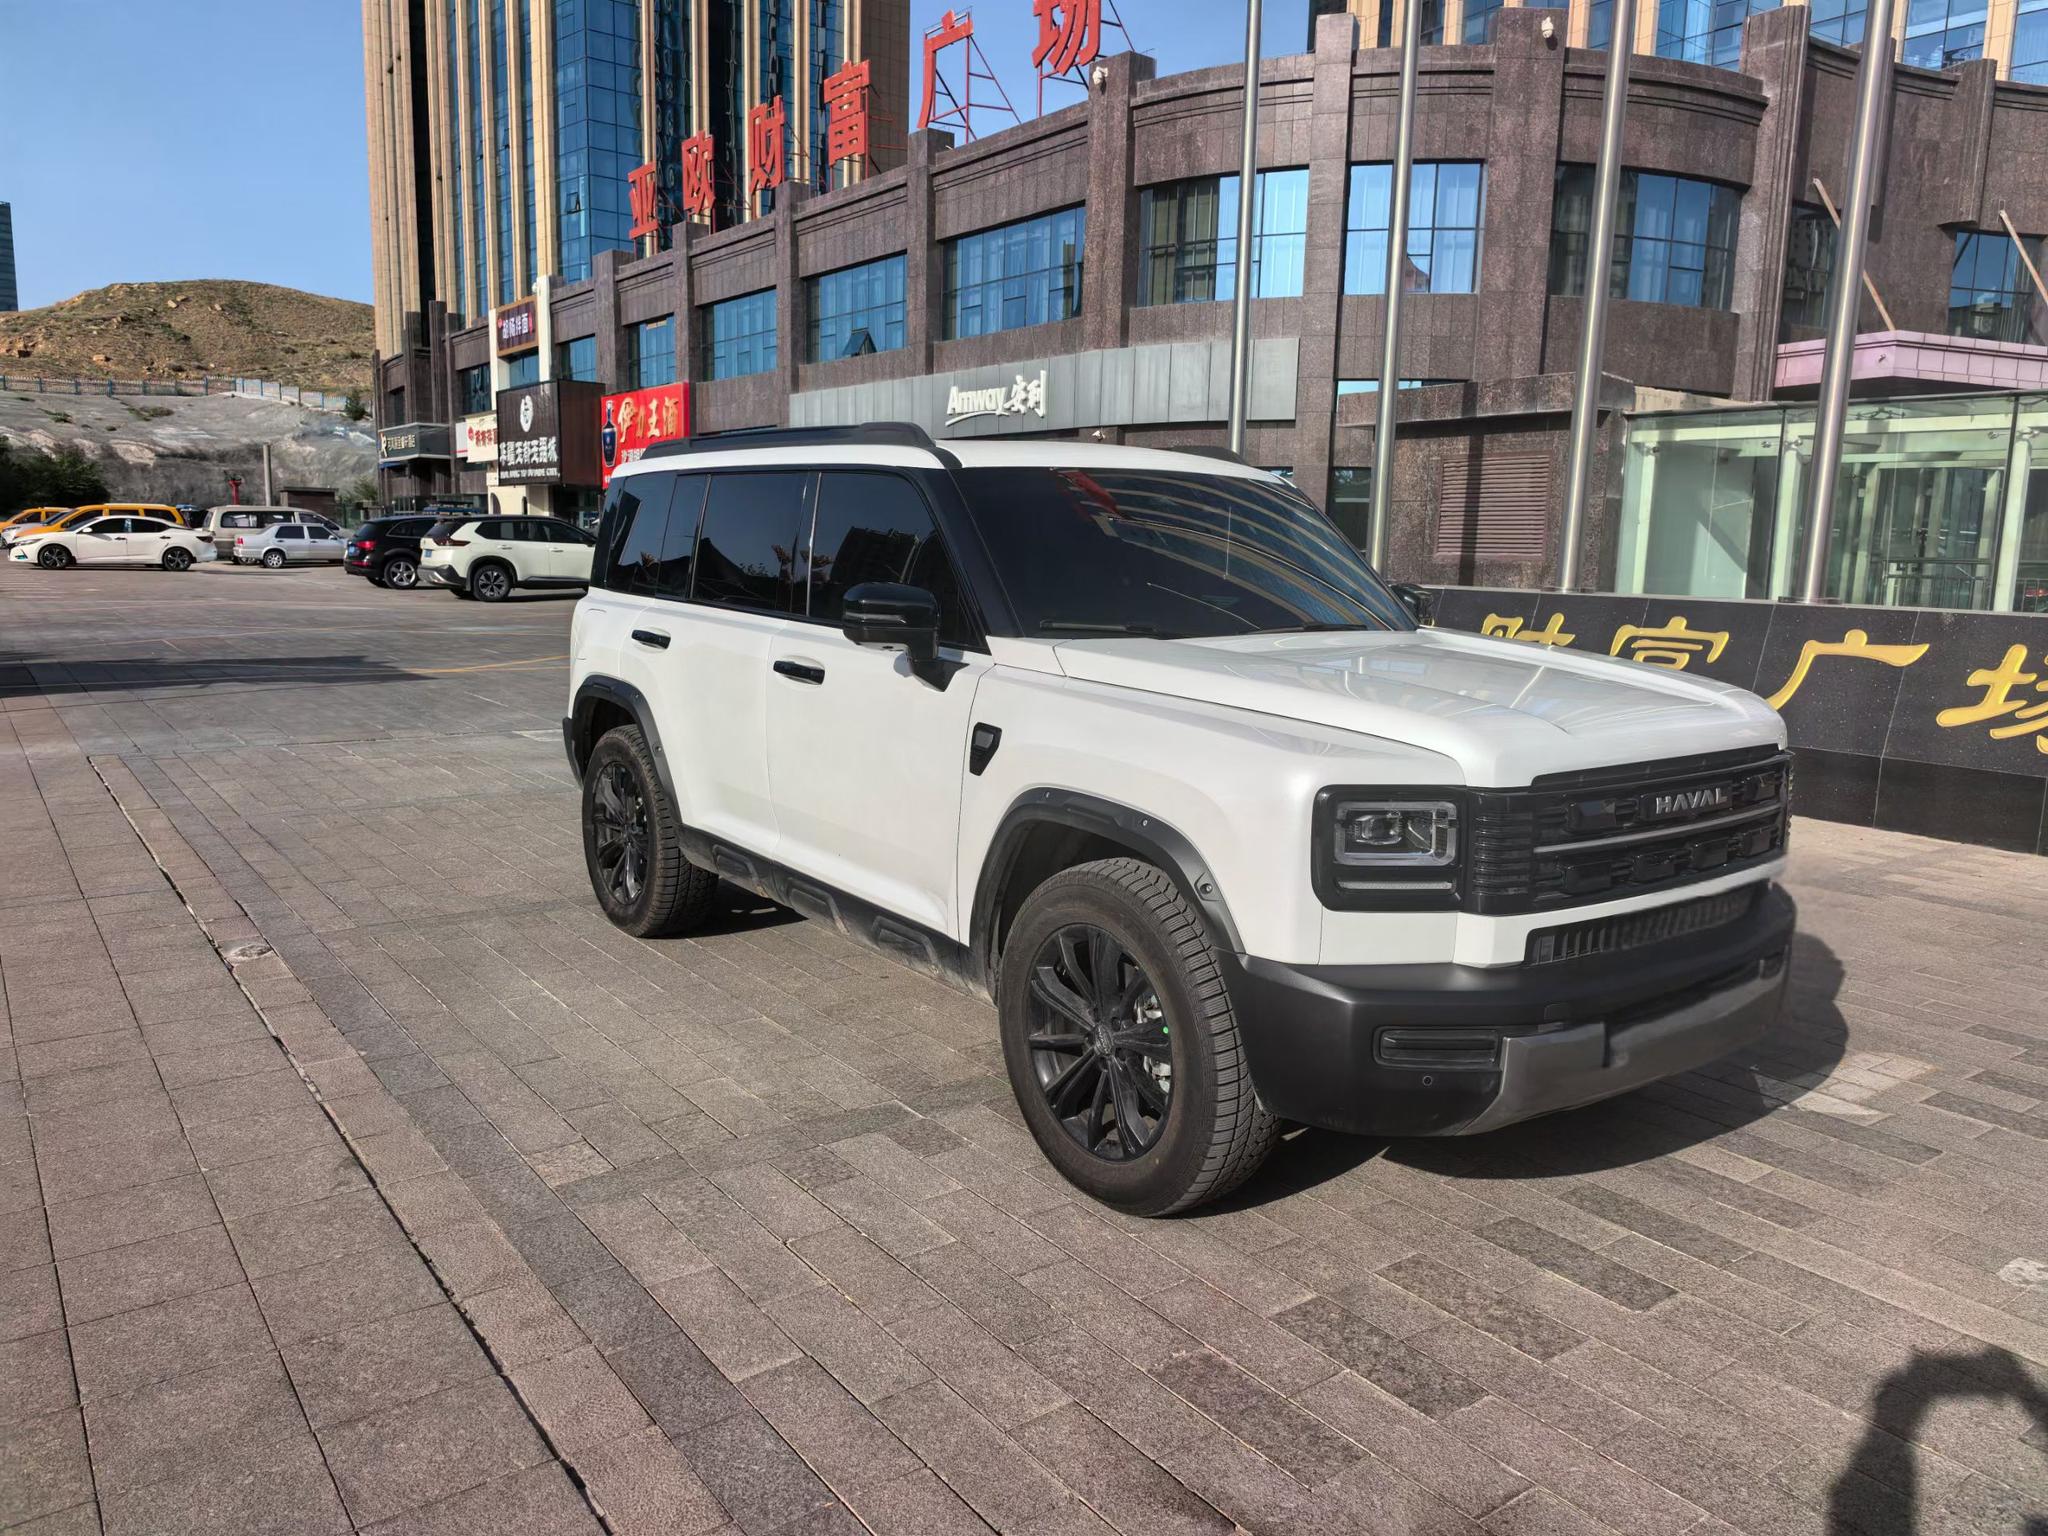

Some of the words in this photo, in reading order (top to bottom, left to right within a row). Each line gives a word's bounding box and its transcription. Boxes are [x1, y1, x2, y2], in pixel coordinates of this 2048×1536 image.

[946, 386, 1008, 416] Amway
[1004, 370, 1047, 418] 安利
[1655, 787, 1728, 815] HAVAL
